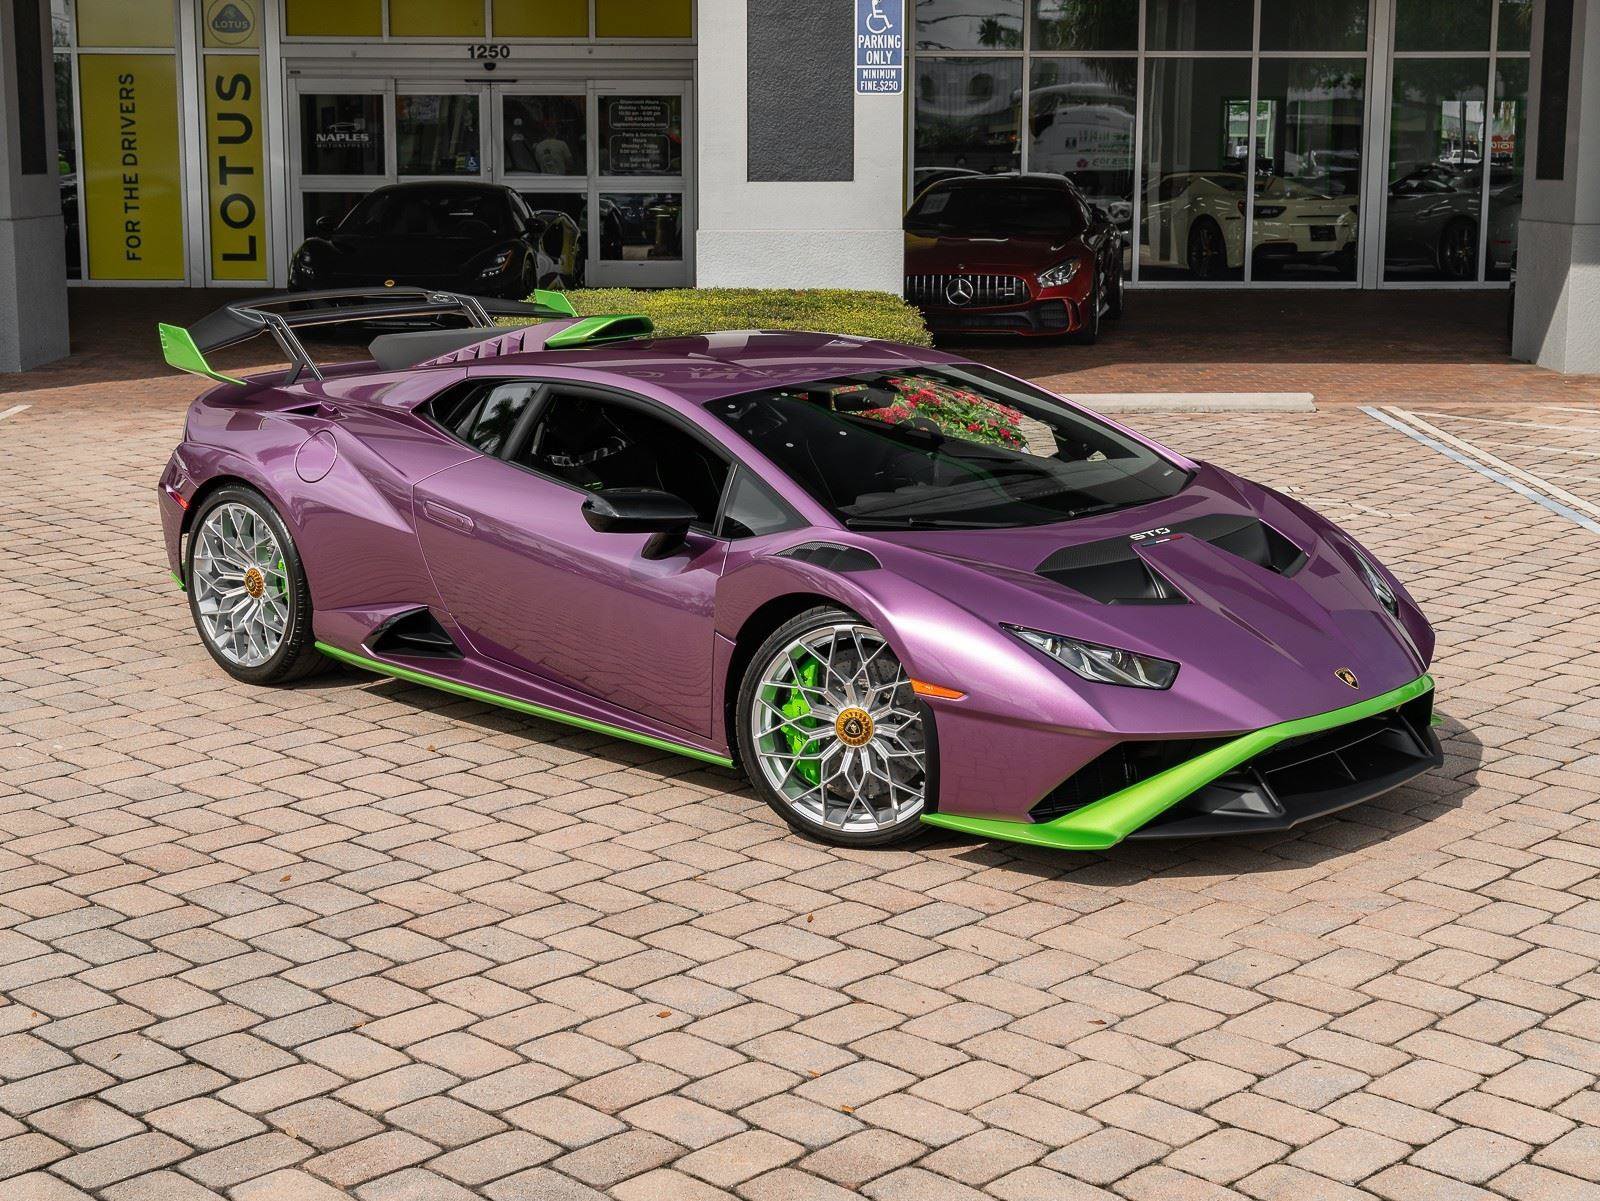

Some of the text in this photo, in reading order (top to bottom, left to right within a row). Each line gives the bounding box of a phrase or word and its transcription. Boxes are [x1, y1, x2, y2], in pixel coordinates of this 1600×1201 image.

[215, 20, 248, 29] LOTUS
[858, 34, 901, 49] PARKING
[467, 44, 511, 59] 1250
[865, 50, 893, 65] ONLY
[862, 69, 896, 79] MINIMUM
[860, 80, 898, 91] FINE $250
[316, 133, 369, 142] NAPLES
[119, 73, 142, 261] FOR THE DRIVERS
[215, 73, 257, 262] LOTUS
[1129, 527, 1171, 541] STO
